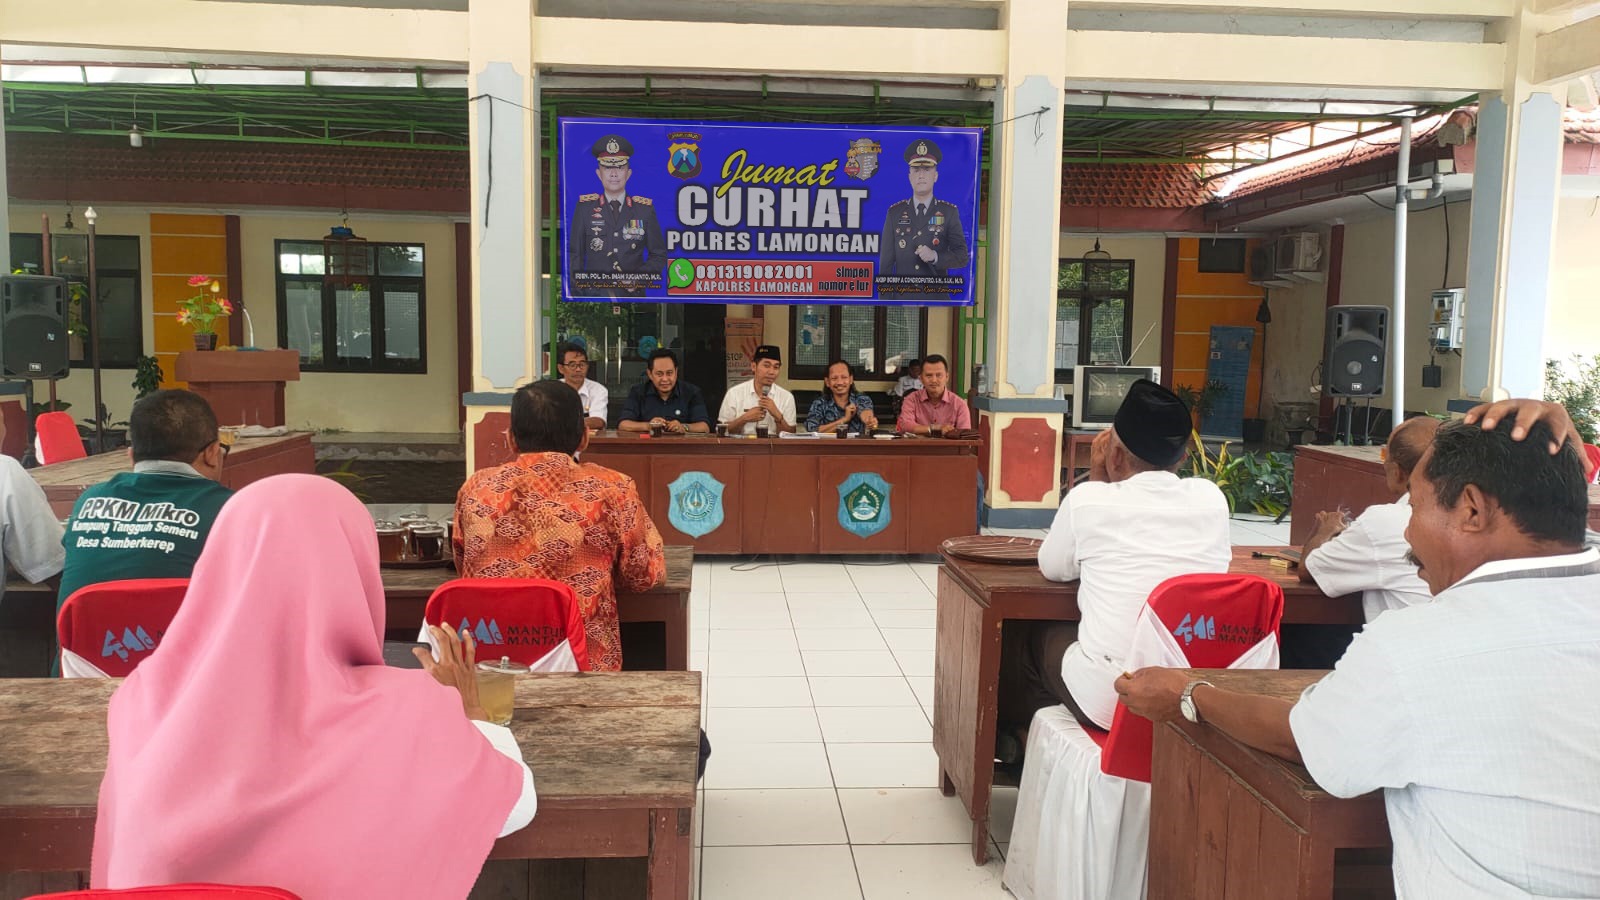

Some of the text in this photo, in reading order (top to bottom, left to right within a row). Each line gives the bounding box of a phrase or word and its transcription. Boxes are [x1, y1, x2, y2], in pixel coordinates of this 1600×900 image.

[716, 149, 839, 198] Jumat
[678, 185, 868, 228] CURHAT
[667, 231, 880, 253] POLRES LAMONGAN
[695, 264, 813, 280] 081319082001
[836, 265, 870, 279] simpen
[695, 280, 813, 293] KAPOLRES LAMONGAN
[818, 279, 848, 291] nomor
[856, 280, 870, 291] lur
[78, 498, 200, 526] PPKM Mikro
[72, 520, 199, 540] Kampung Tangguh Semeru
[76, 536, 175, 553] Desa Sumberkerep
